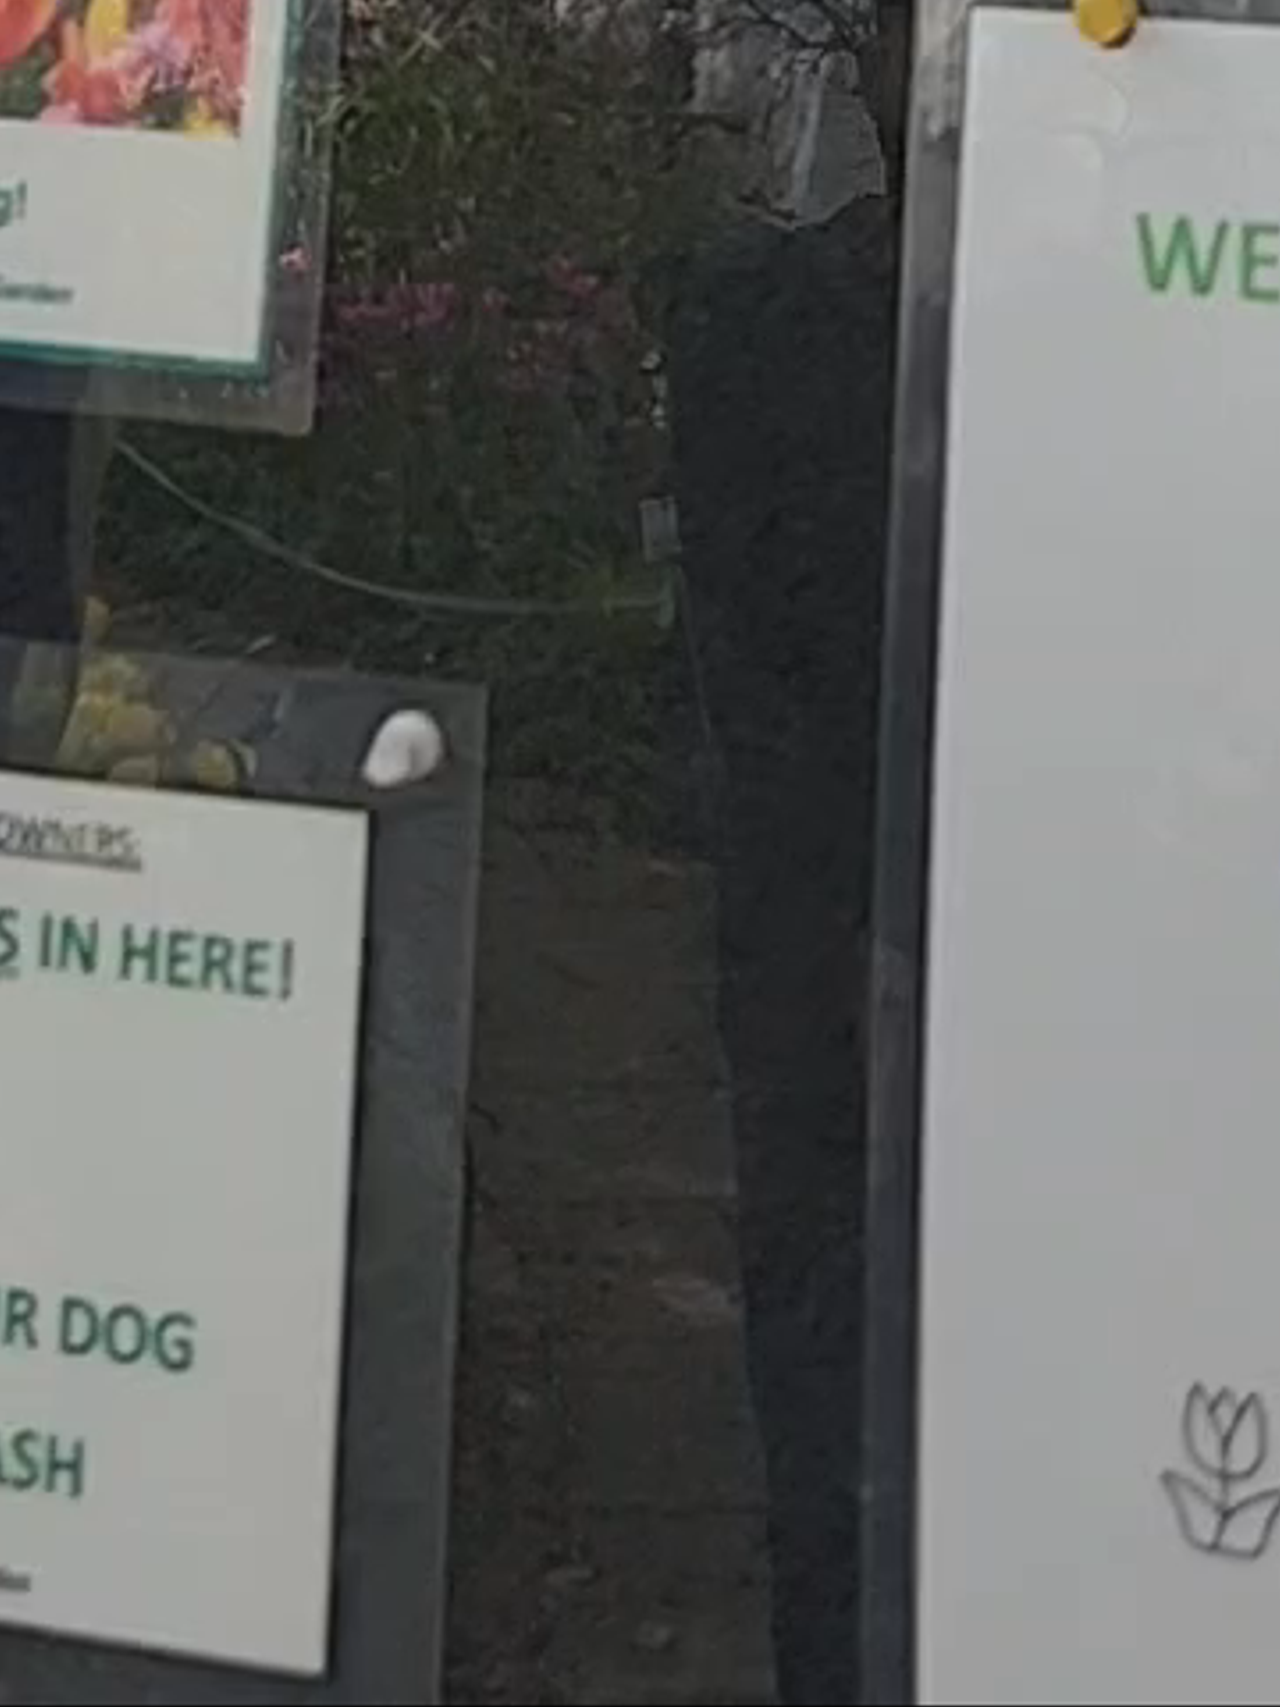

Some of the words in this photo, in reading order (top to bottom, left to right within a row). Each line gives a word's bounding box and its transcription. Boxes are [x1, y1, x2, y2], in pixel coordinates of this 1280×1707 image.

[38, 913, 101, 976] IN
[119, 925, 297, 1000] HERE!
[58, 1302, 197, 1374] DOG
